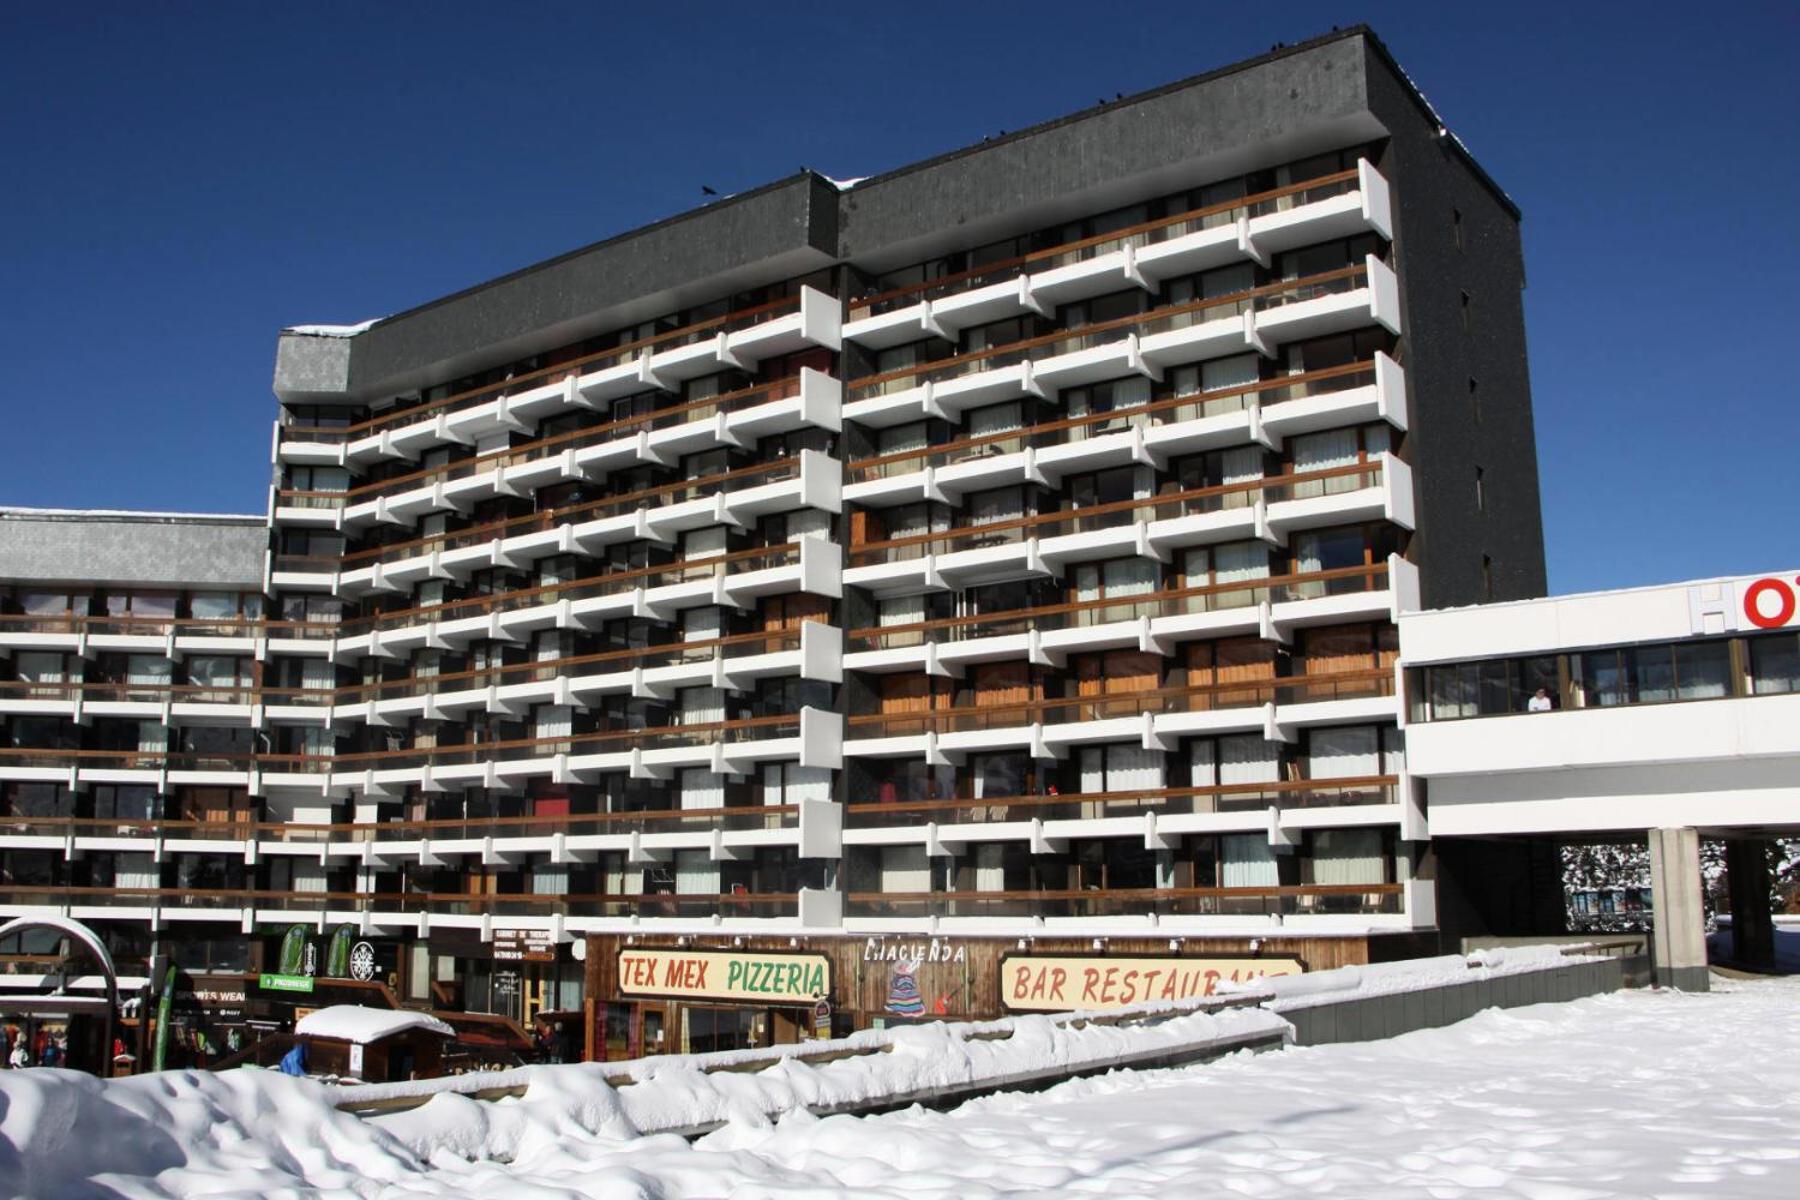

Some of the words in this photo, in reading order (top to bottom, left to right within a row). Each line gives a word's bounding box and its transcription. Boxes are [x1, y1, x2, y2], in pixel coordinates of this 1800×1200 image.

[1688, 577, 1800, 635] HO
[623, 957, 657, 987] TEX
[664, 959, 709, 990] MEX
[727, 960, 825, 995] PIZZERIA
[1013, 966, 1068, 1002] BAR
[1082, 966, 1289, 1005] RESTAUR
